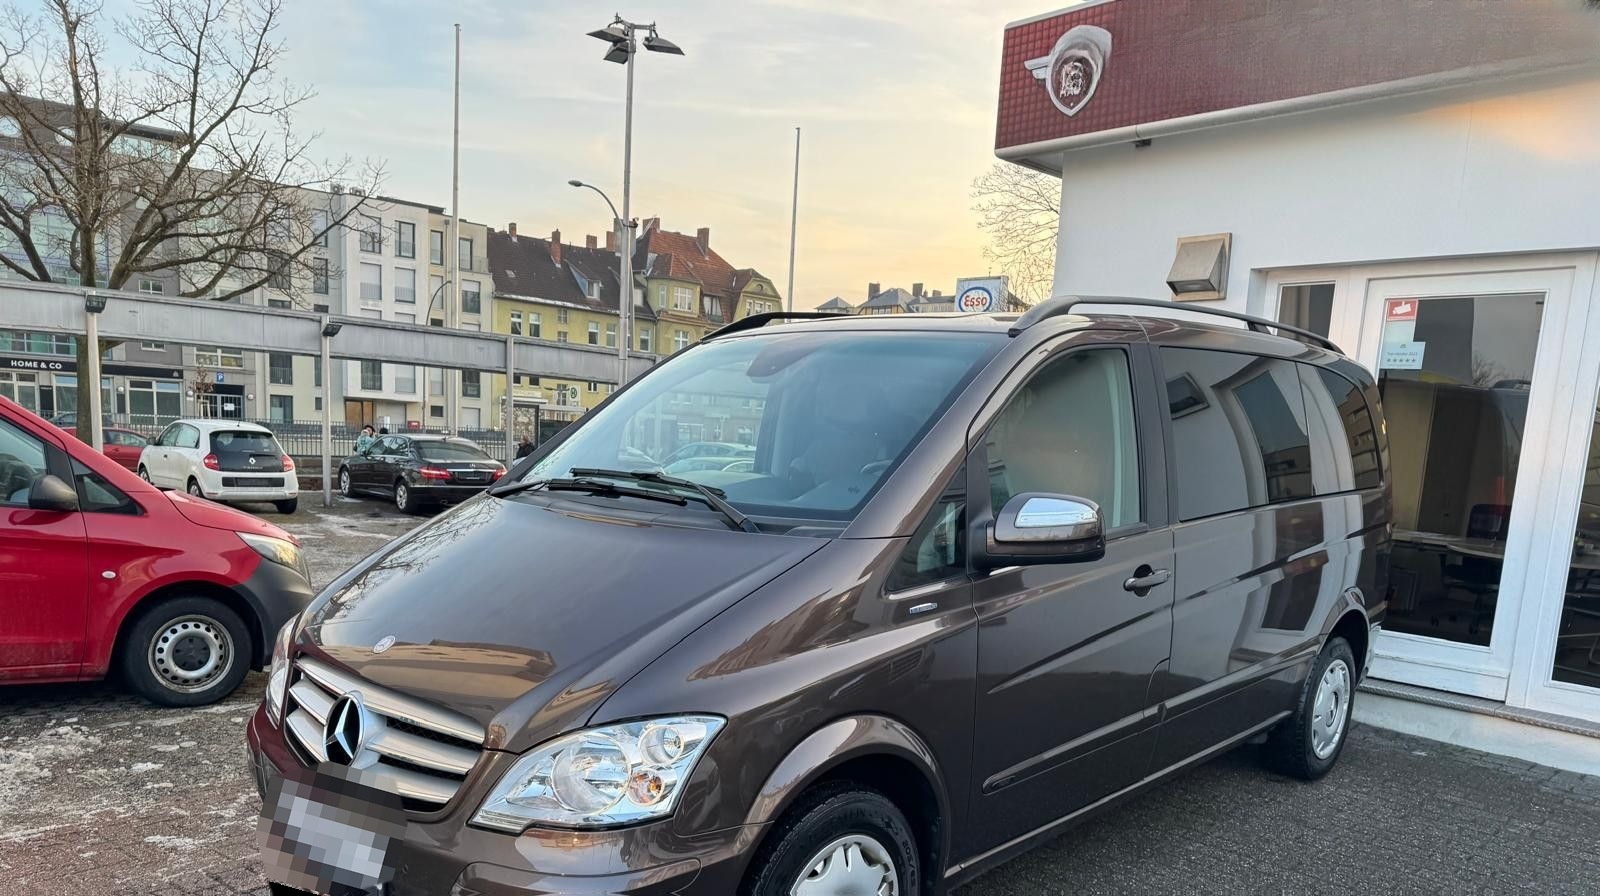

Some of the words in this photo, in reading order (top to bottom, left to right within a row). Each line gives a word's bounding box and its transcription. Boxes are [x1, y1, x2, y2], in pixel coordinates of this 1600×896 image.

[964, 294, 988, 307] Esso
[11, 359, 38, 368] HOME
[40, 361, 47, 369] &
